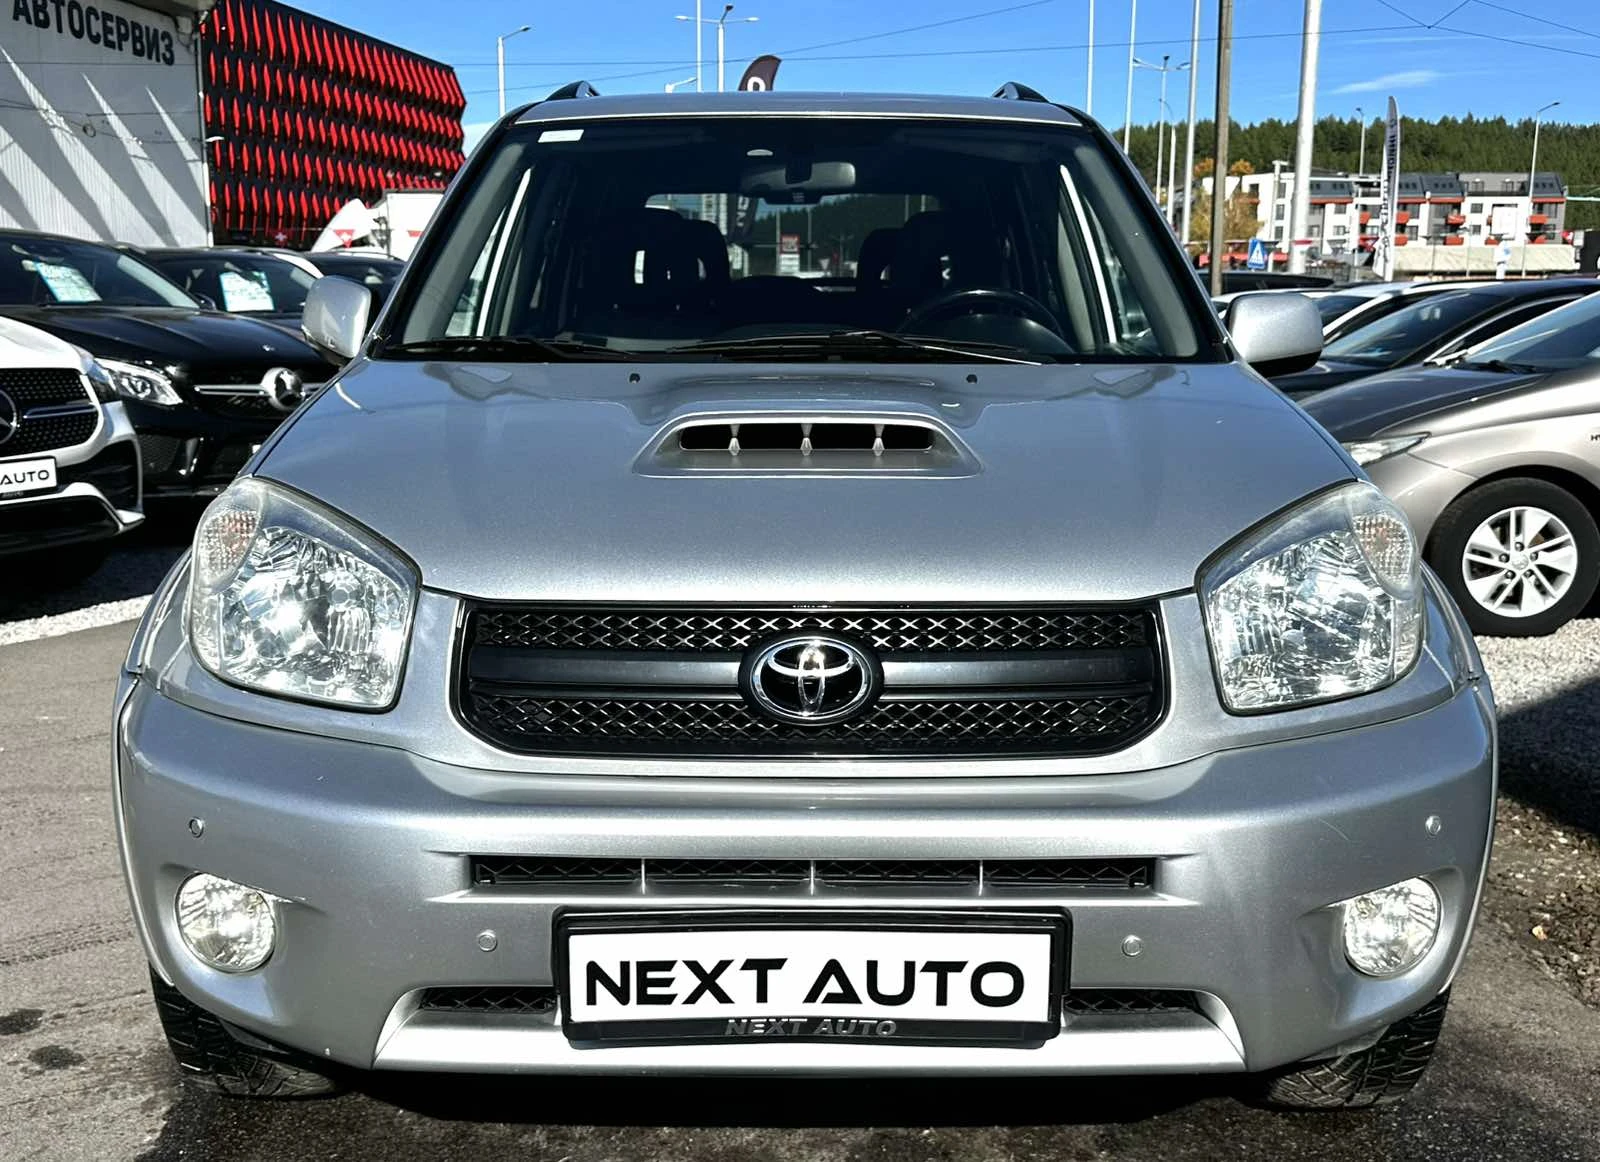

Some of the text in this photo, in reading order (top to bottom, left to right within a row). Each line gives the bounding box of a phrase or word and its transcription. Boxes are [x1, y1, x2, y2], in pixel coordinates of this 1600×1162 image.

[12, 0, 175, 66] АВТОСЕРВИЗ
[0, 469, 50, 486] AUTO
[586, 958, 1025, 1007] NEXT AUTO
[725, 1018, 897, 1037] NEXT AUTO
